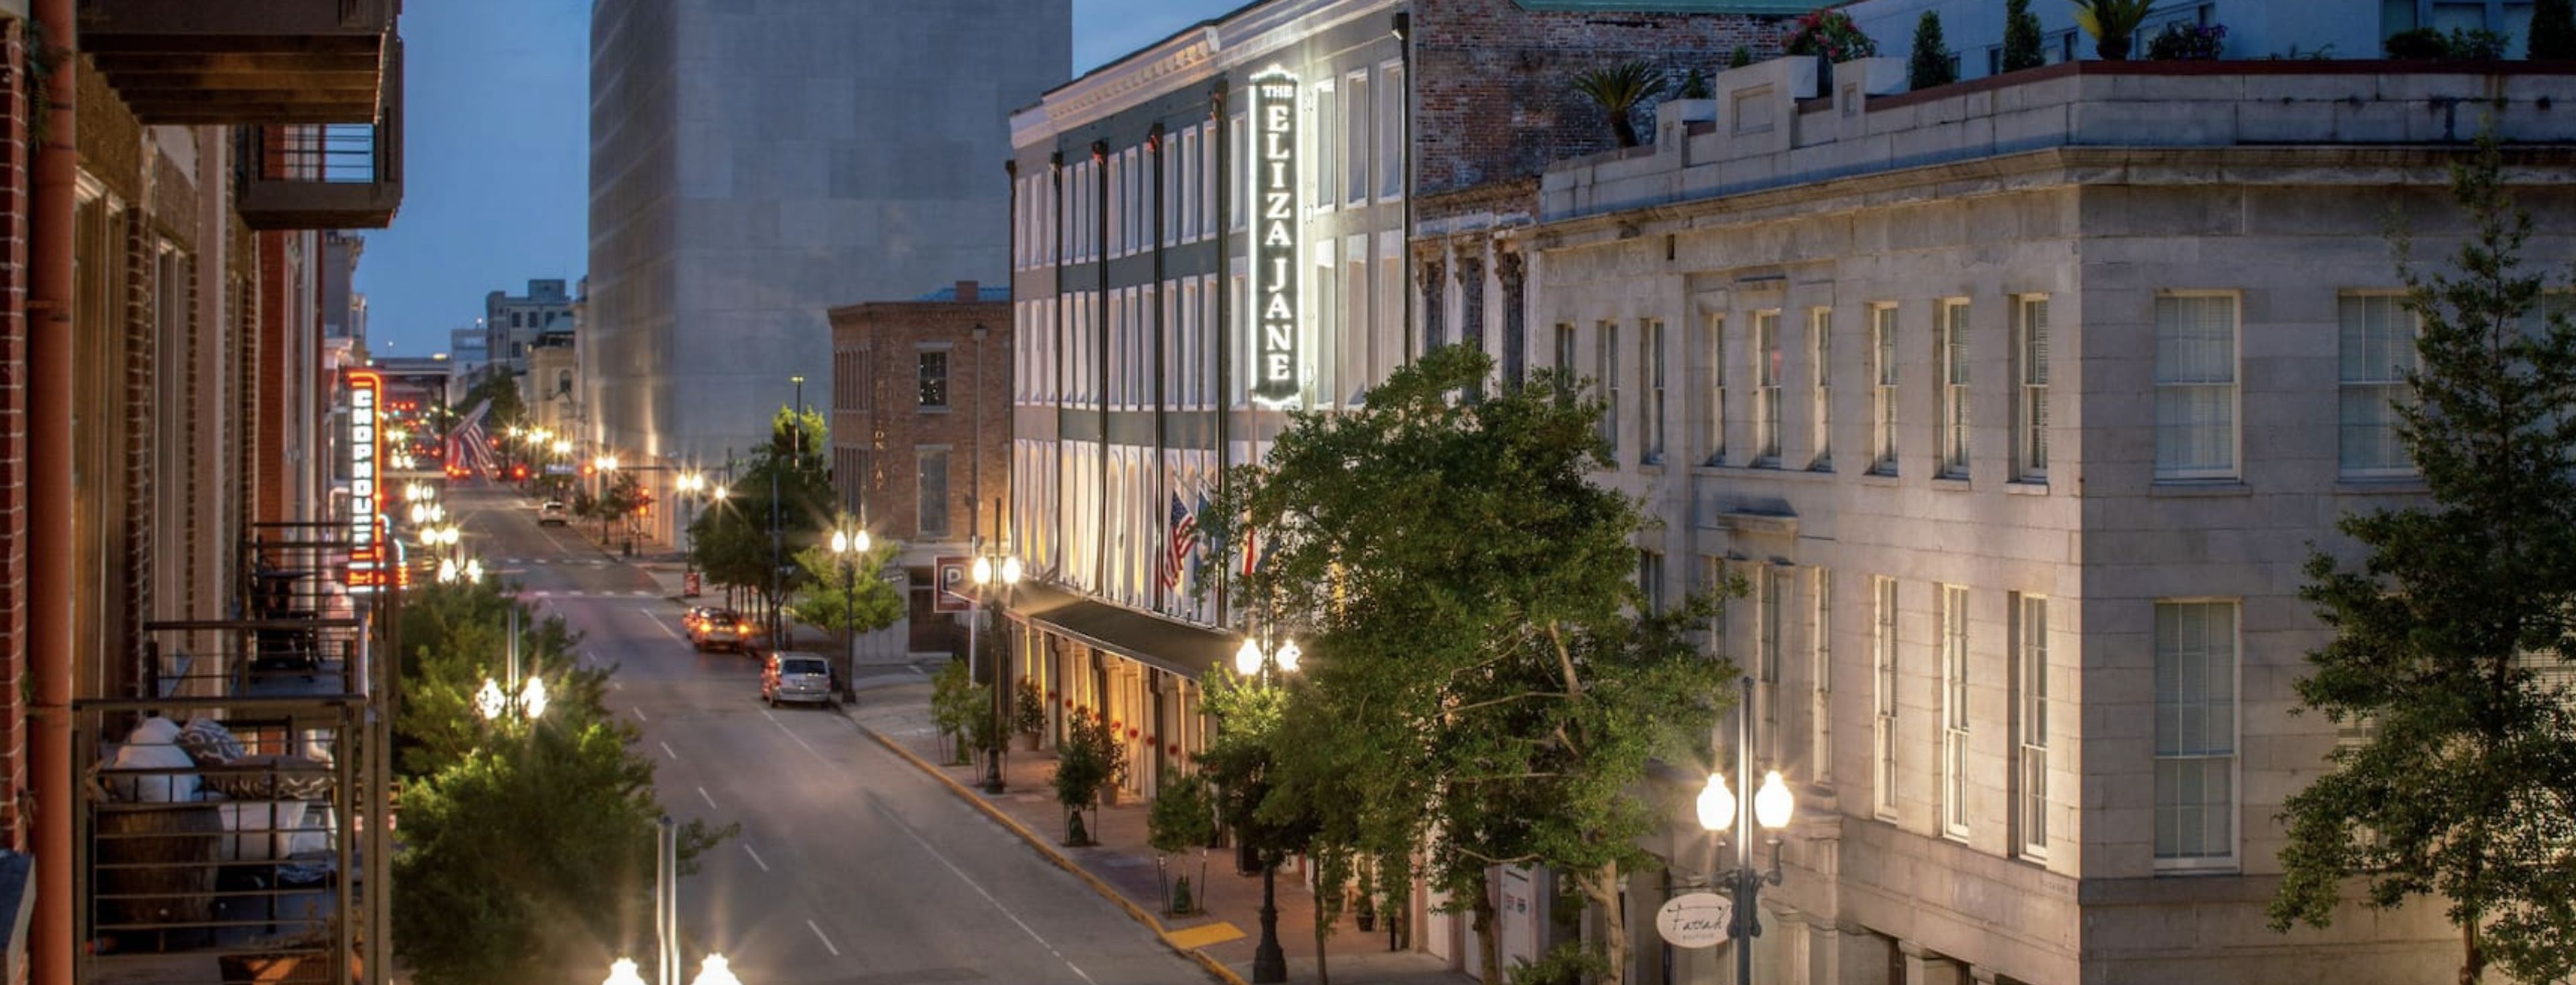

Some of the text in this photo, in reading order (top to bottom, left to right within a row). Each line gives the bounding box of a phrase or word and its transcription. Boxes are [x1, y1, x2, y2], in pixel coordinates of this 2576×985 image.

[1261, 85, 1293, 98] THE
[1265, 105, 1291, 381] ELIZA JANE
[352, 388, 372, 551] CHOPHOUSE
[946, 568, 961, 591] P
